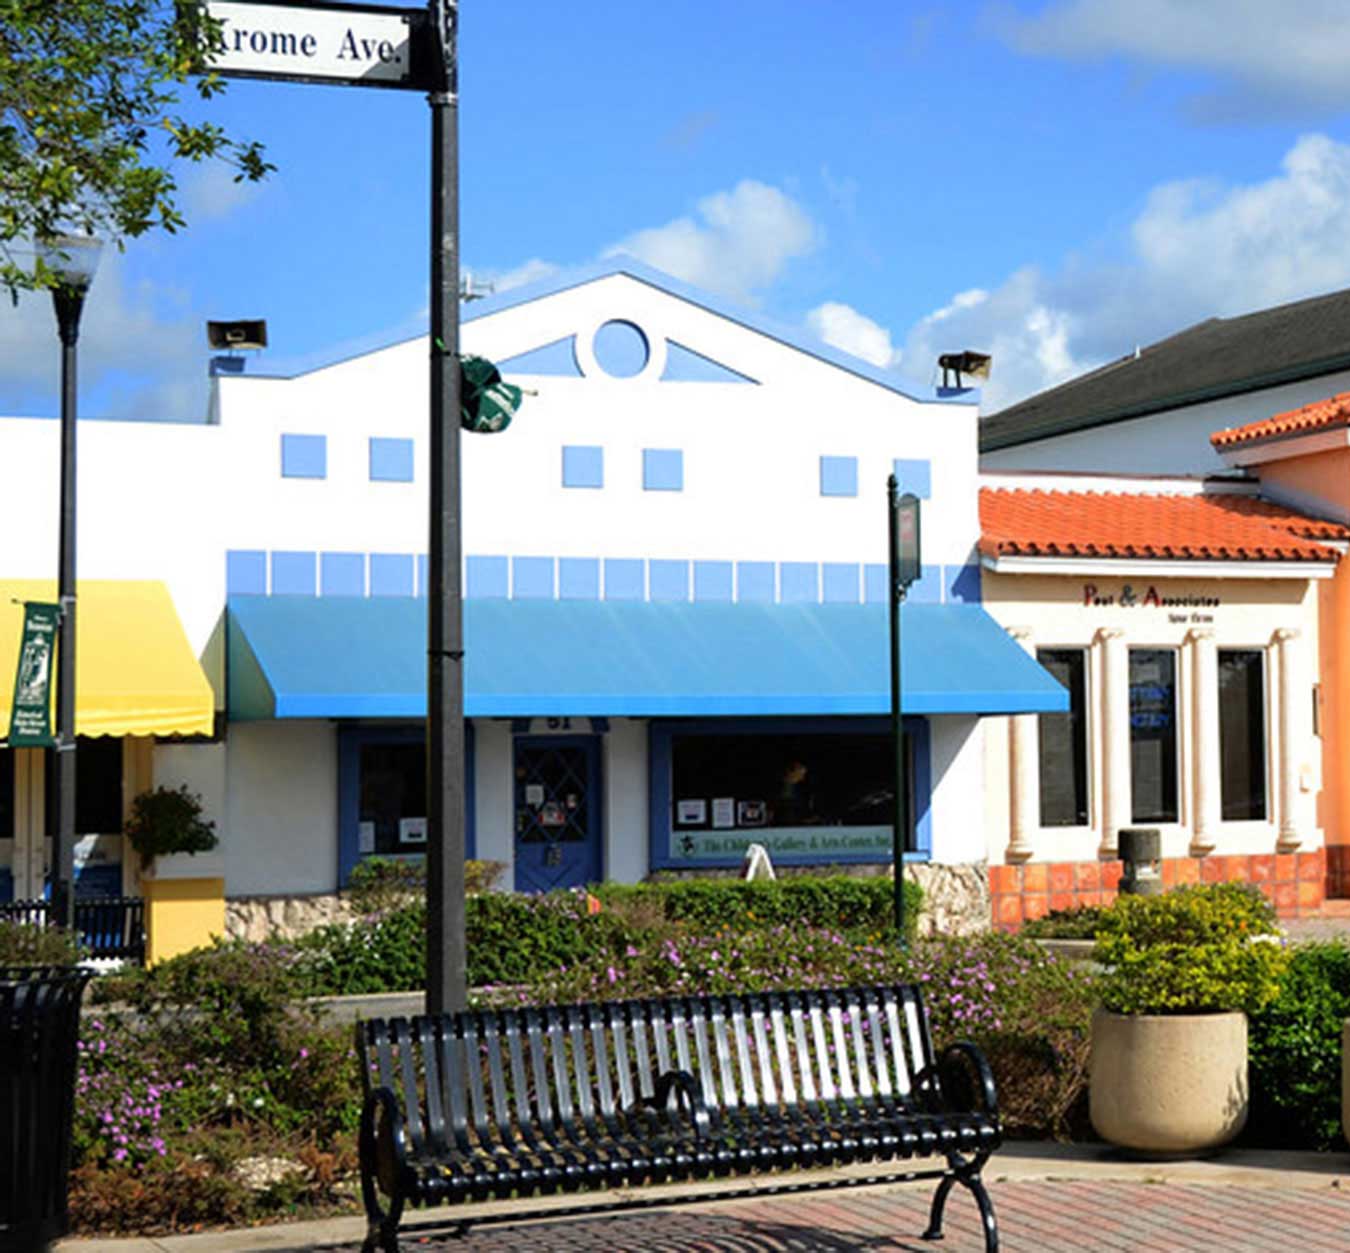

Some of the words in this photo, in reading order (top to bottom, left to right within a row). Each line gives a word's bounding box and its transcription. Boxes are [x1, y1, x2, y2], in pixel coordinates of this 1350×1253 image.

[336, 27, 402, 63] Ave.
[1119, 583, 1137, 607] &
[1142, 585, 1221, 608] Associates
